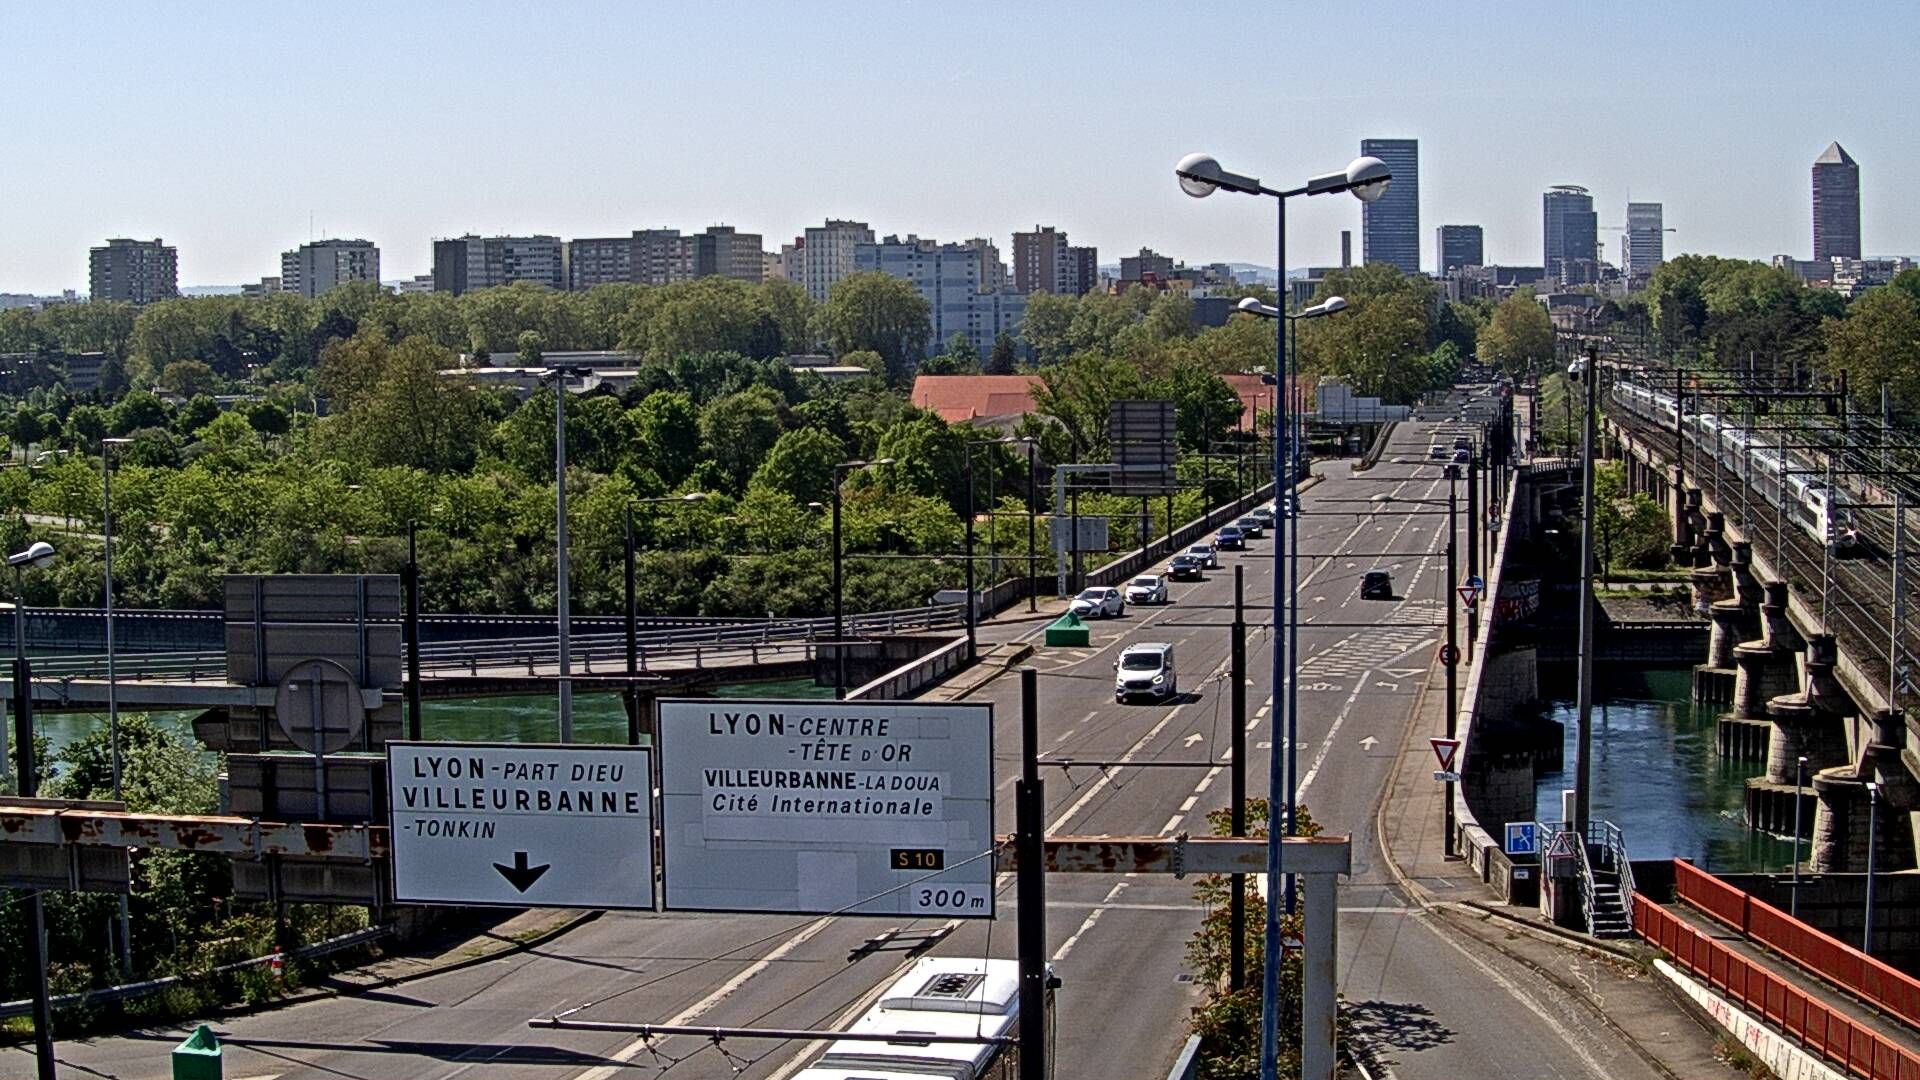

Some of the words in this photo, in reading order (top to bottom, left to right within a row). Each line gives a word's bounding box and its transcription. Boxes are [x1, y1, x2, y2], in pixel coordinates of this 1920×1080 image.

[570, 764, 624, 783] DIEU
[402, 786, 640, 814] VILLEURBANNE
[712, 793, 758, 812] Cité
[771, 794, 933, 816] Internationale
[918, 889, 966, 908] 300
[970, 897, 985, 908] m
